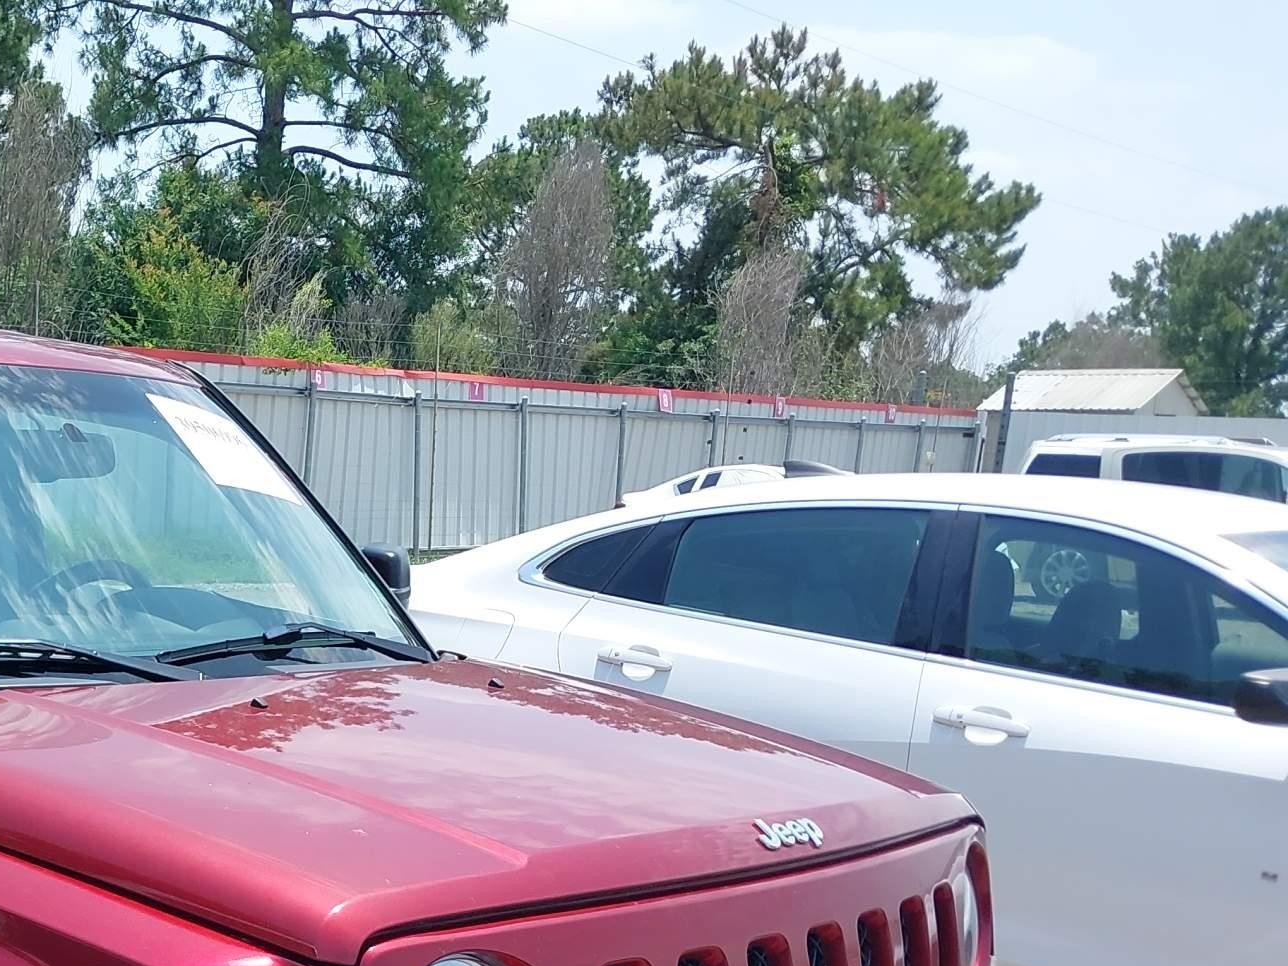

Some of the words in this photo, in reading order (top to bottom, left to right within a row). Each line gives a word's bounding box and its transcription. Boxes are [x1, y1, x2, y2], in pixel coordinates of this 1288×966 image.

[315, 370, 322, 385] 6
[473, 383, 480, 396] 7
[753, 818, 823, 849] Jeep
